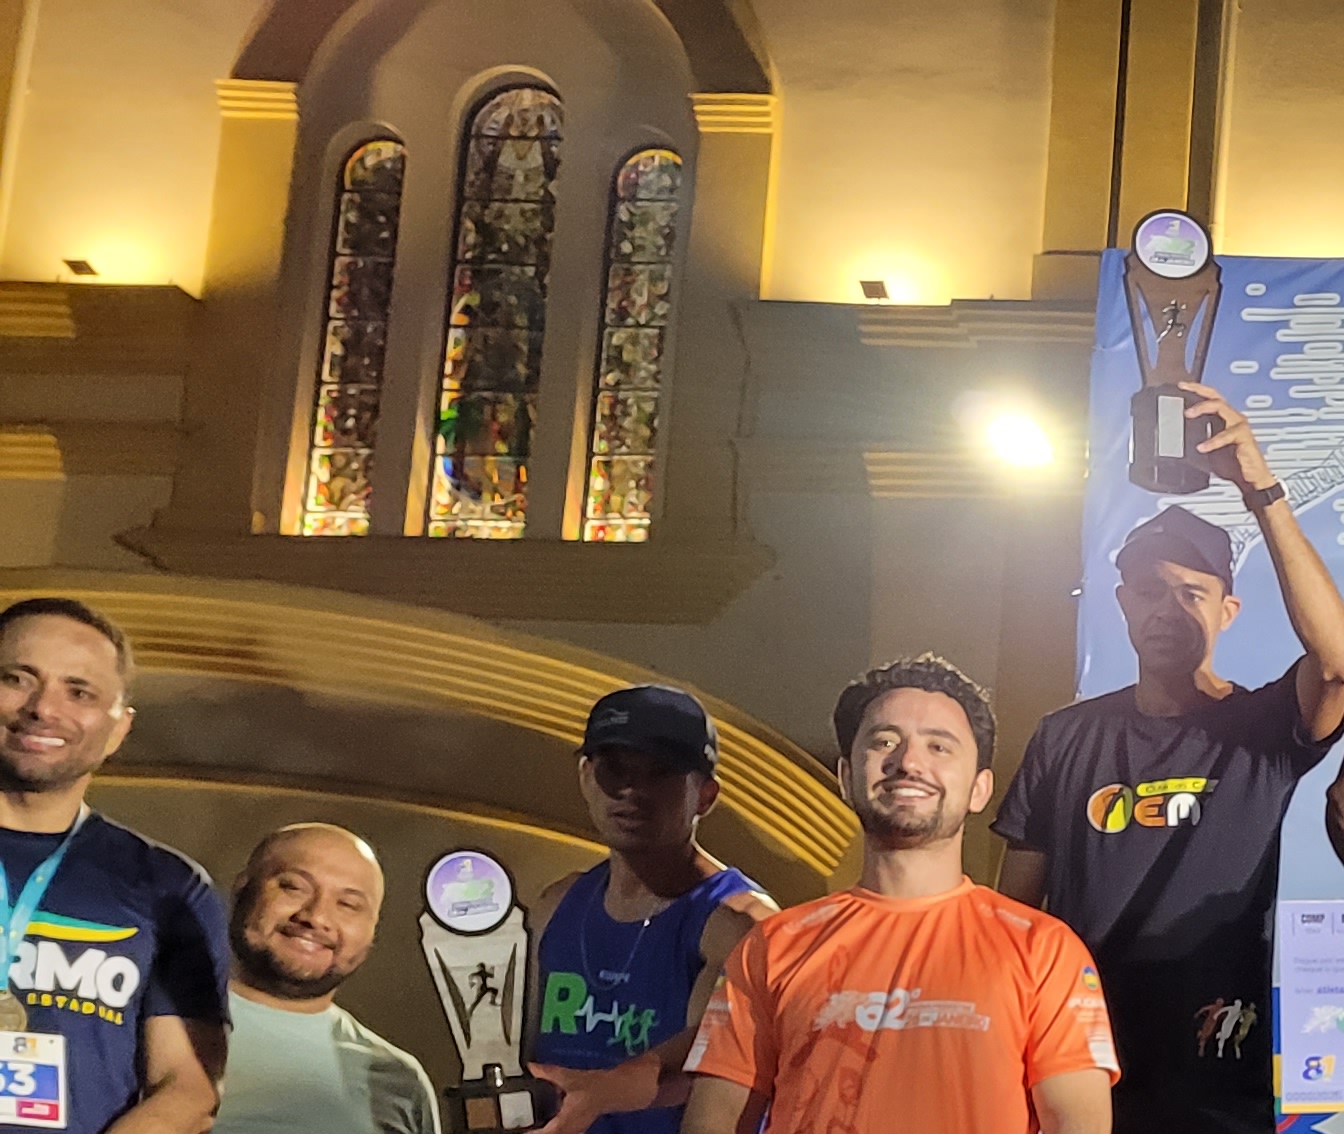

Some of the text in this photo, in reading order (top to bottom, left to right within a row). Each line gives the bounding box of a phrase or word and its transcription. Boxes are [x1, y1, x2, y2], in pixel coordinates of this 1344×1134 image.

[1301, 913, 1325, 924] COMP
[8, 941, 140, 1008] RMO
[1316, 985, 1344, 994] atleta
[1303, 1055, 1337, 1082] 81
